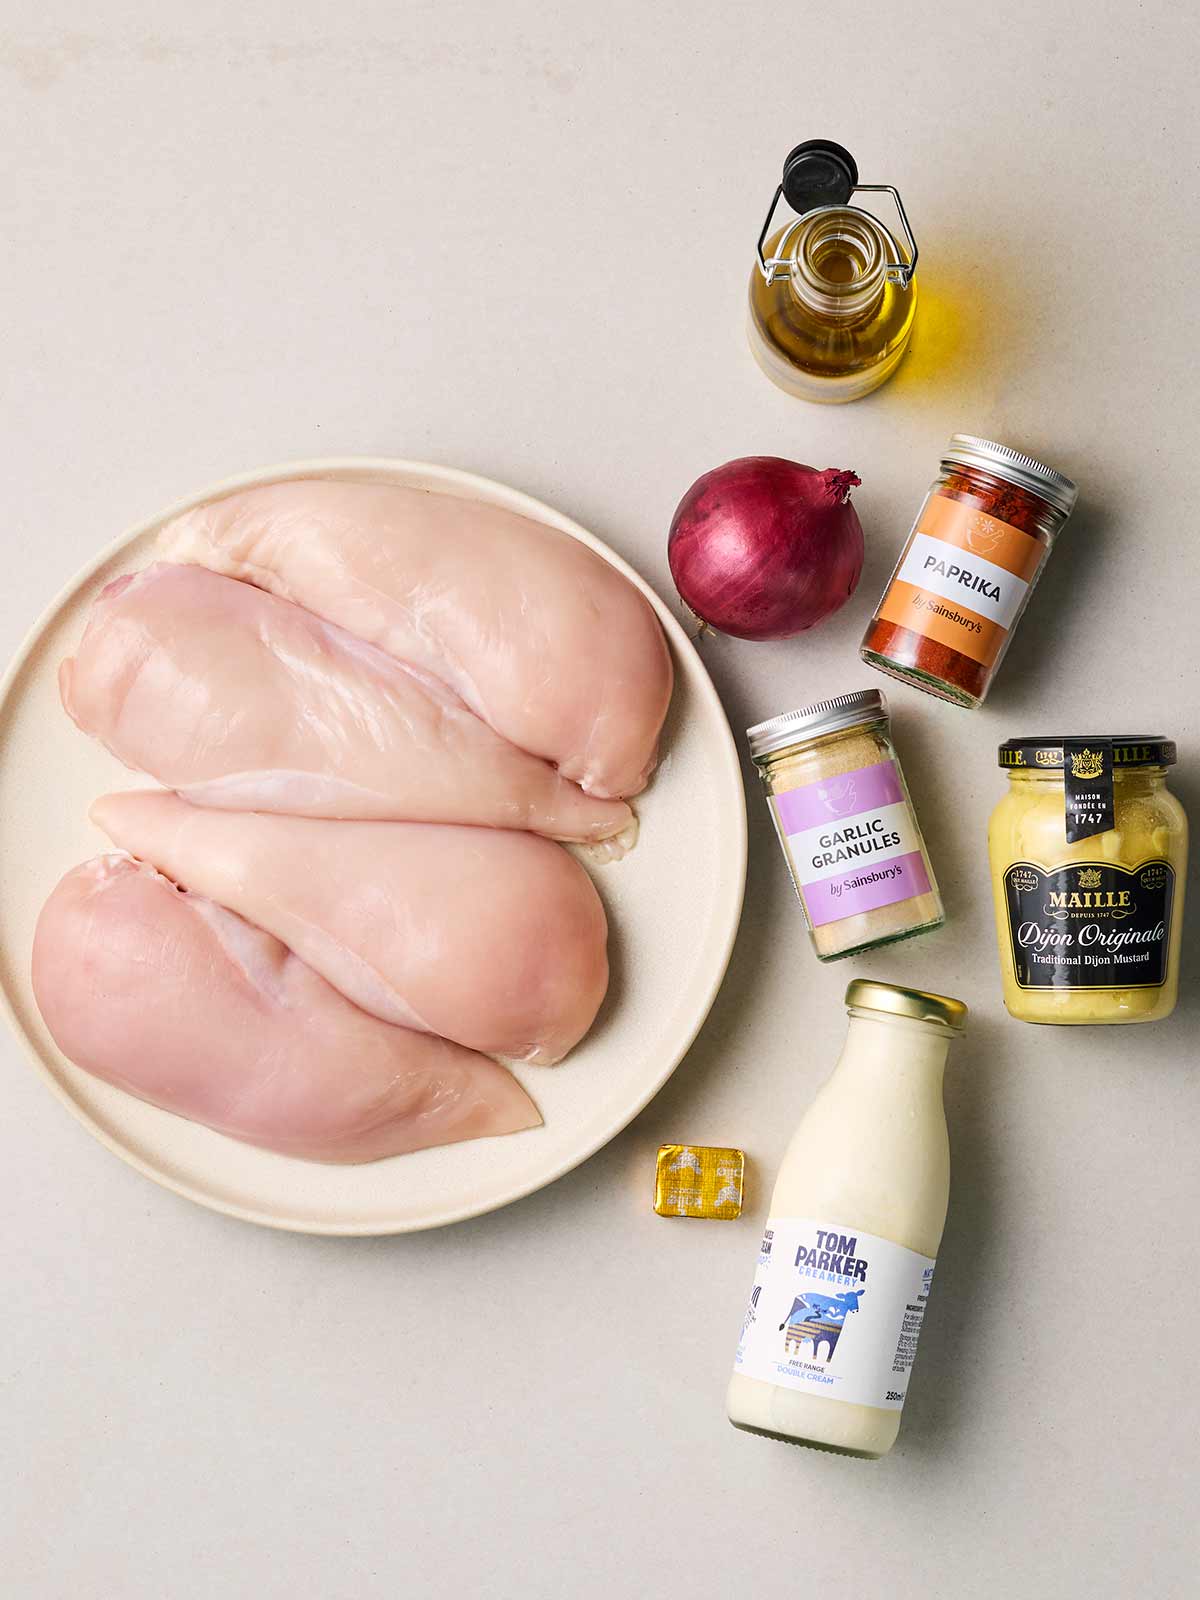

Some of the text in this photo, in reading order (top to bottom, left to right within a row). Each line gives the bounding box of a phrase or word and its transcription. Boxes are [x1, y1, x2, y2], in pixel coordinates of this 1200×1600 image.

[923, 556, 1001, 602] PAPRIKA
[912, 592, 983, 634] by Sainsbury's
[1070, 801, 1095, 810] FONDÉE
[1075, 793, 1101, 801] MAISON
[1075, 813, 1103, 825] 1747
[819, 819, 884, 848] GARLIC
[811, 832, 901, 869] GRANULES
[830, 864, 903, 897] by Sainsbury's
[1016, 870, 1032, 878] 1747
[1049, 890, 1131, 908] MAILLE
[1017, 920, 1165, 953] Dijon Originale
[1032, 951, 1150, 967] Traditional Dijon Mustard
[816, 1230, 857, 1257] TOM
[794, 1245, 868, 1282] PARKER
[798, 1265, 858, 1287] CREAMERY
[777, 1364, 834, 1384] DOUBLE CREAM
[788, 1359, 825, 1373] FREE RANGE
